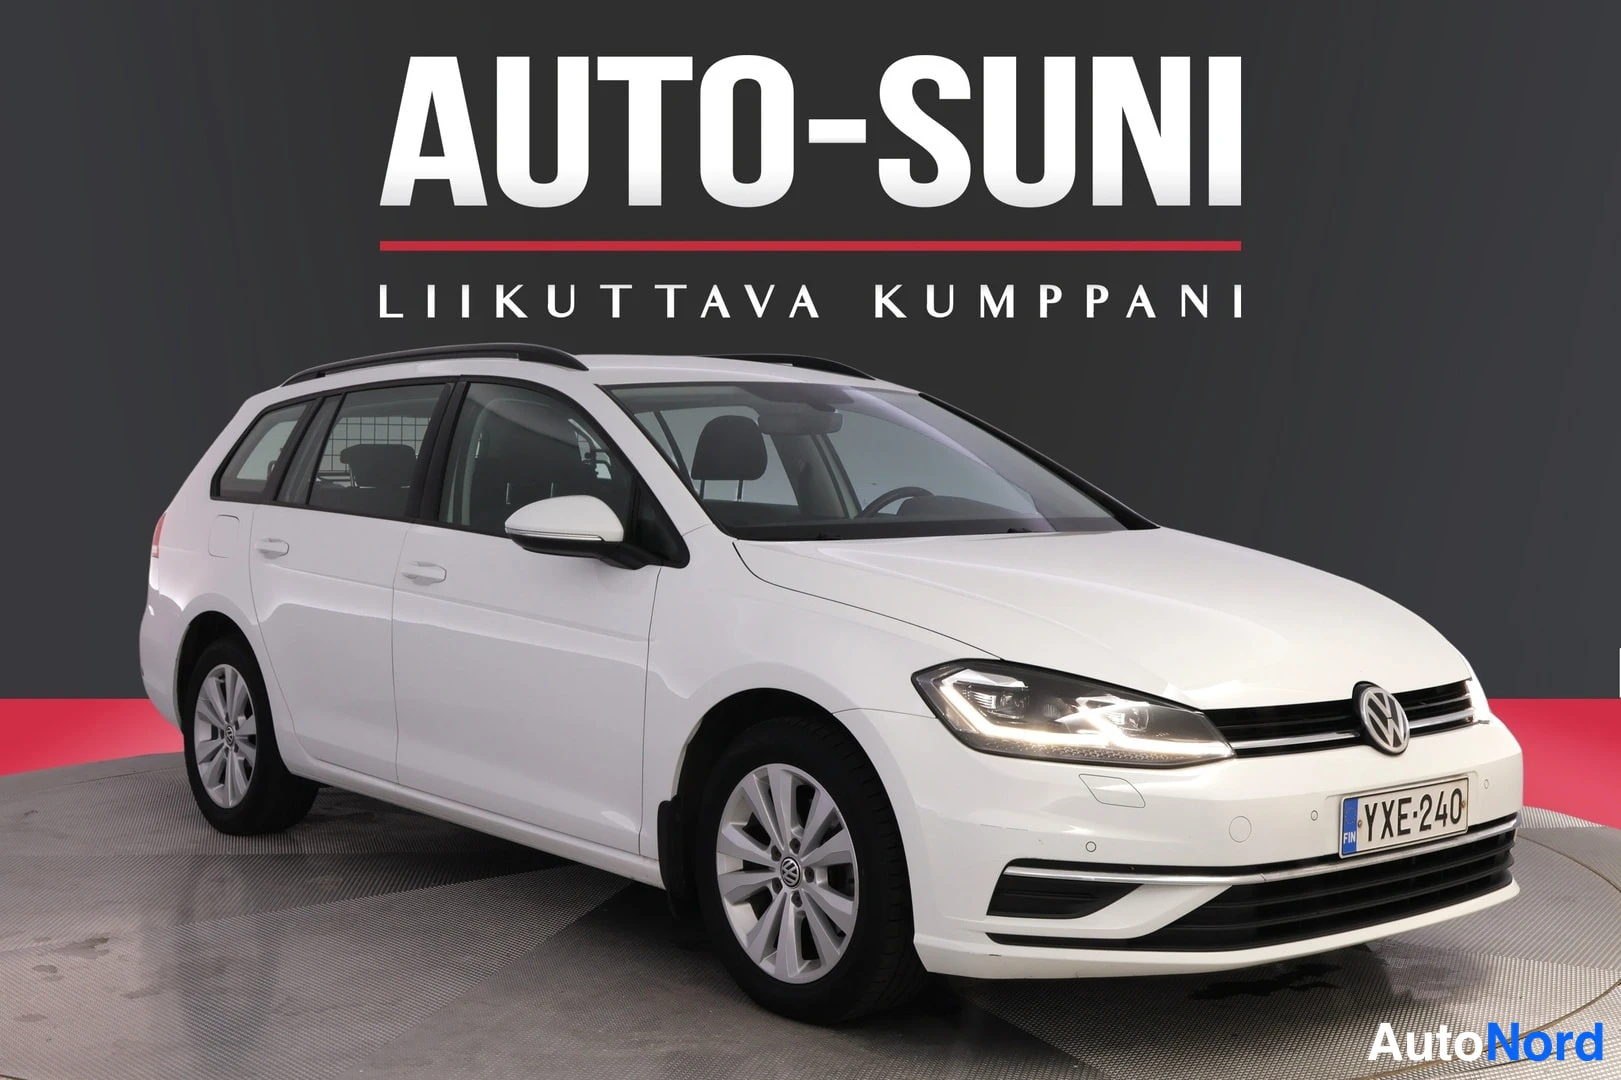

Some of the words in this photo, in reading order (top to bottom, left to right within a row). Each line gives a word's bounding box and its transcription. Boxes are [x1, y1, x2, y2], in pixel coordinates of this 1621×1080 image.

[380, 55, 1241, 207] AUTO-SUNI
[380, 285, 819, 318] LIIKUTTAVA
[875, 285, 1241, 318] KUMPPANI
[1364, 788, 1463, 842] YXE-240
[1343, 830, 1356, 844] FIN
